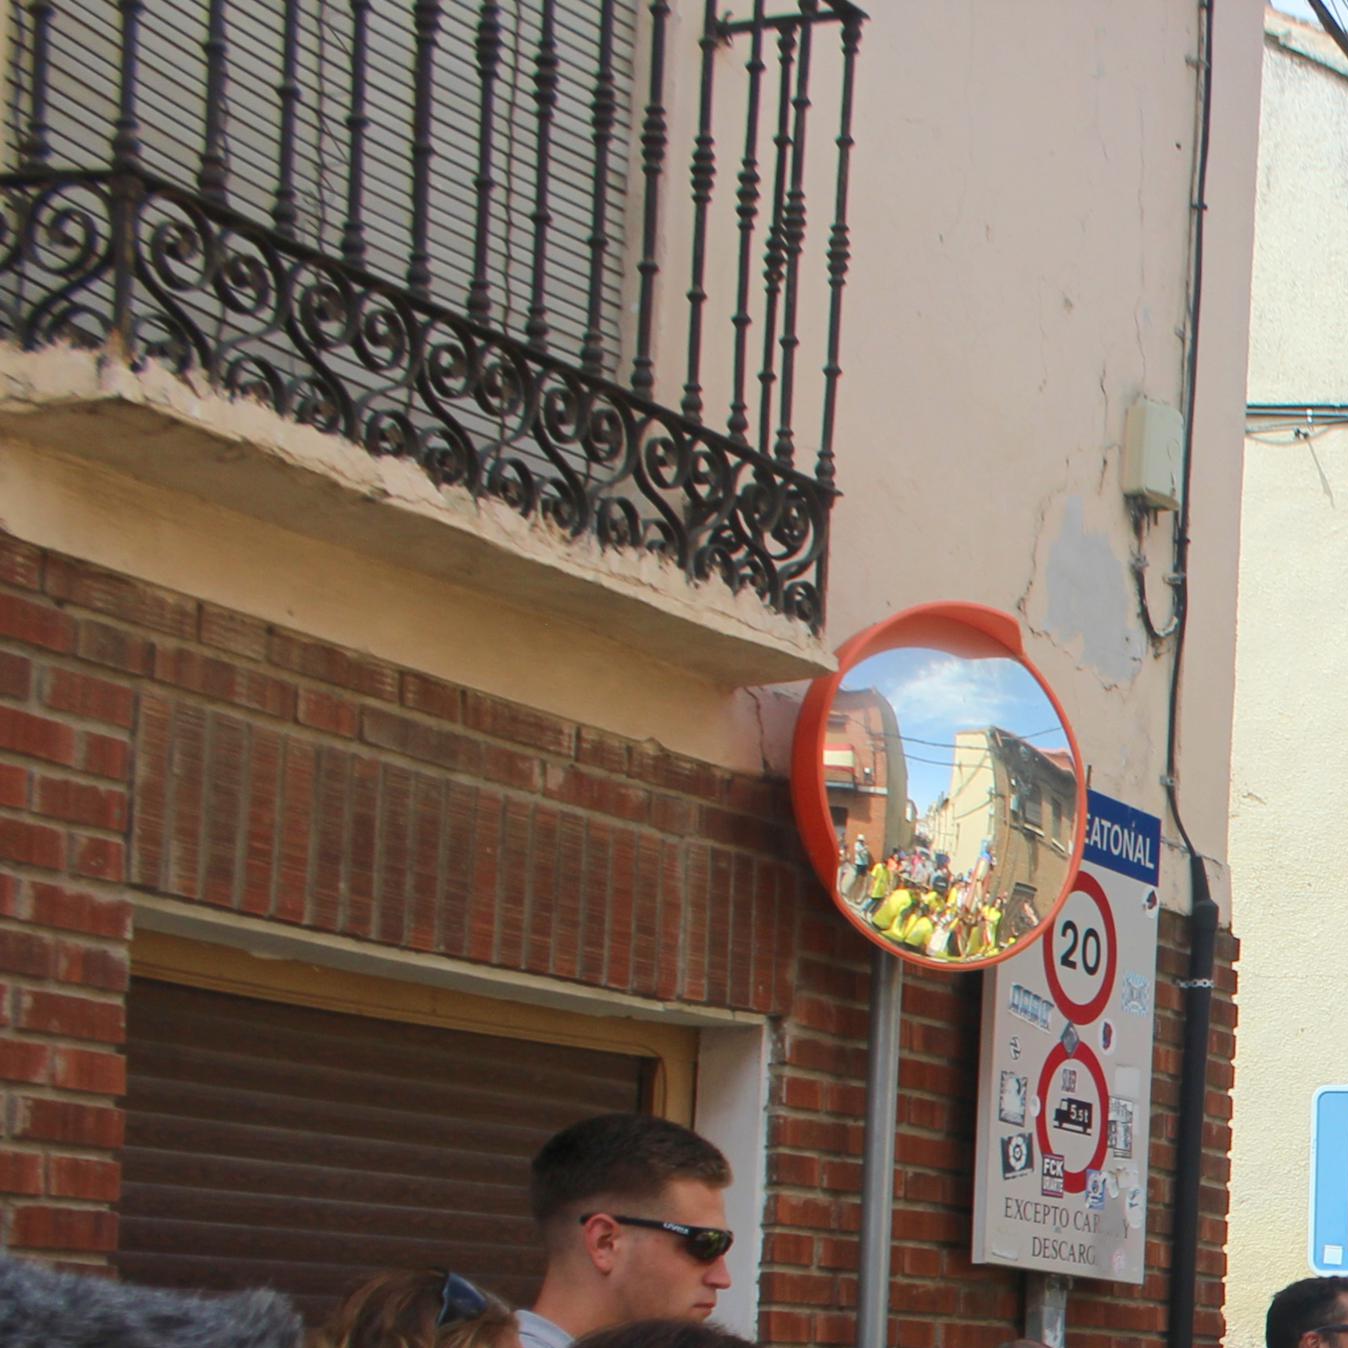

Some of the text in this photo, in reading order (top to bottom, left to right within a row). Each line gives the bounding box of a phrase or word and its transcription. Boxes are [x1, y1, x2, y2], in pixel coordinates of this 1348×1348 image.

[1061, 920, 1101, 976] 20
[1043, 1158, 1064, 1179] FCK
[1004, 1197, 1070, 1228] EXCEPTO
[1122, 1219, 1130, 1239] Y
[1031, 1236, 1096, 1265] DESCARG
